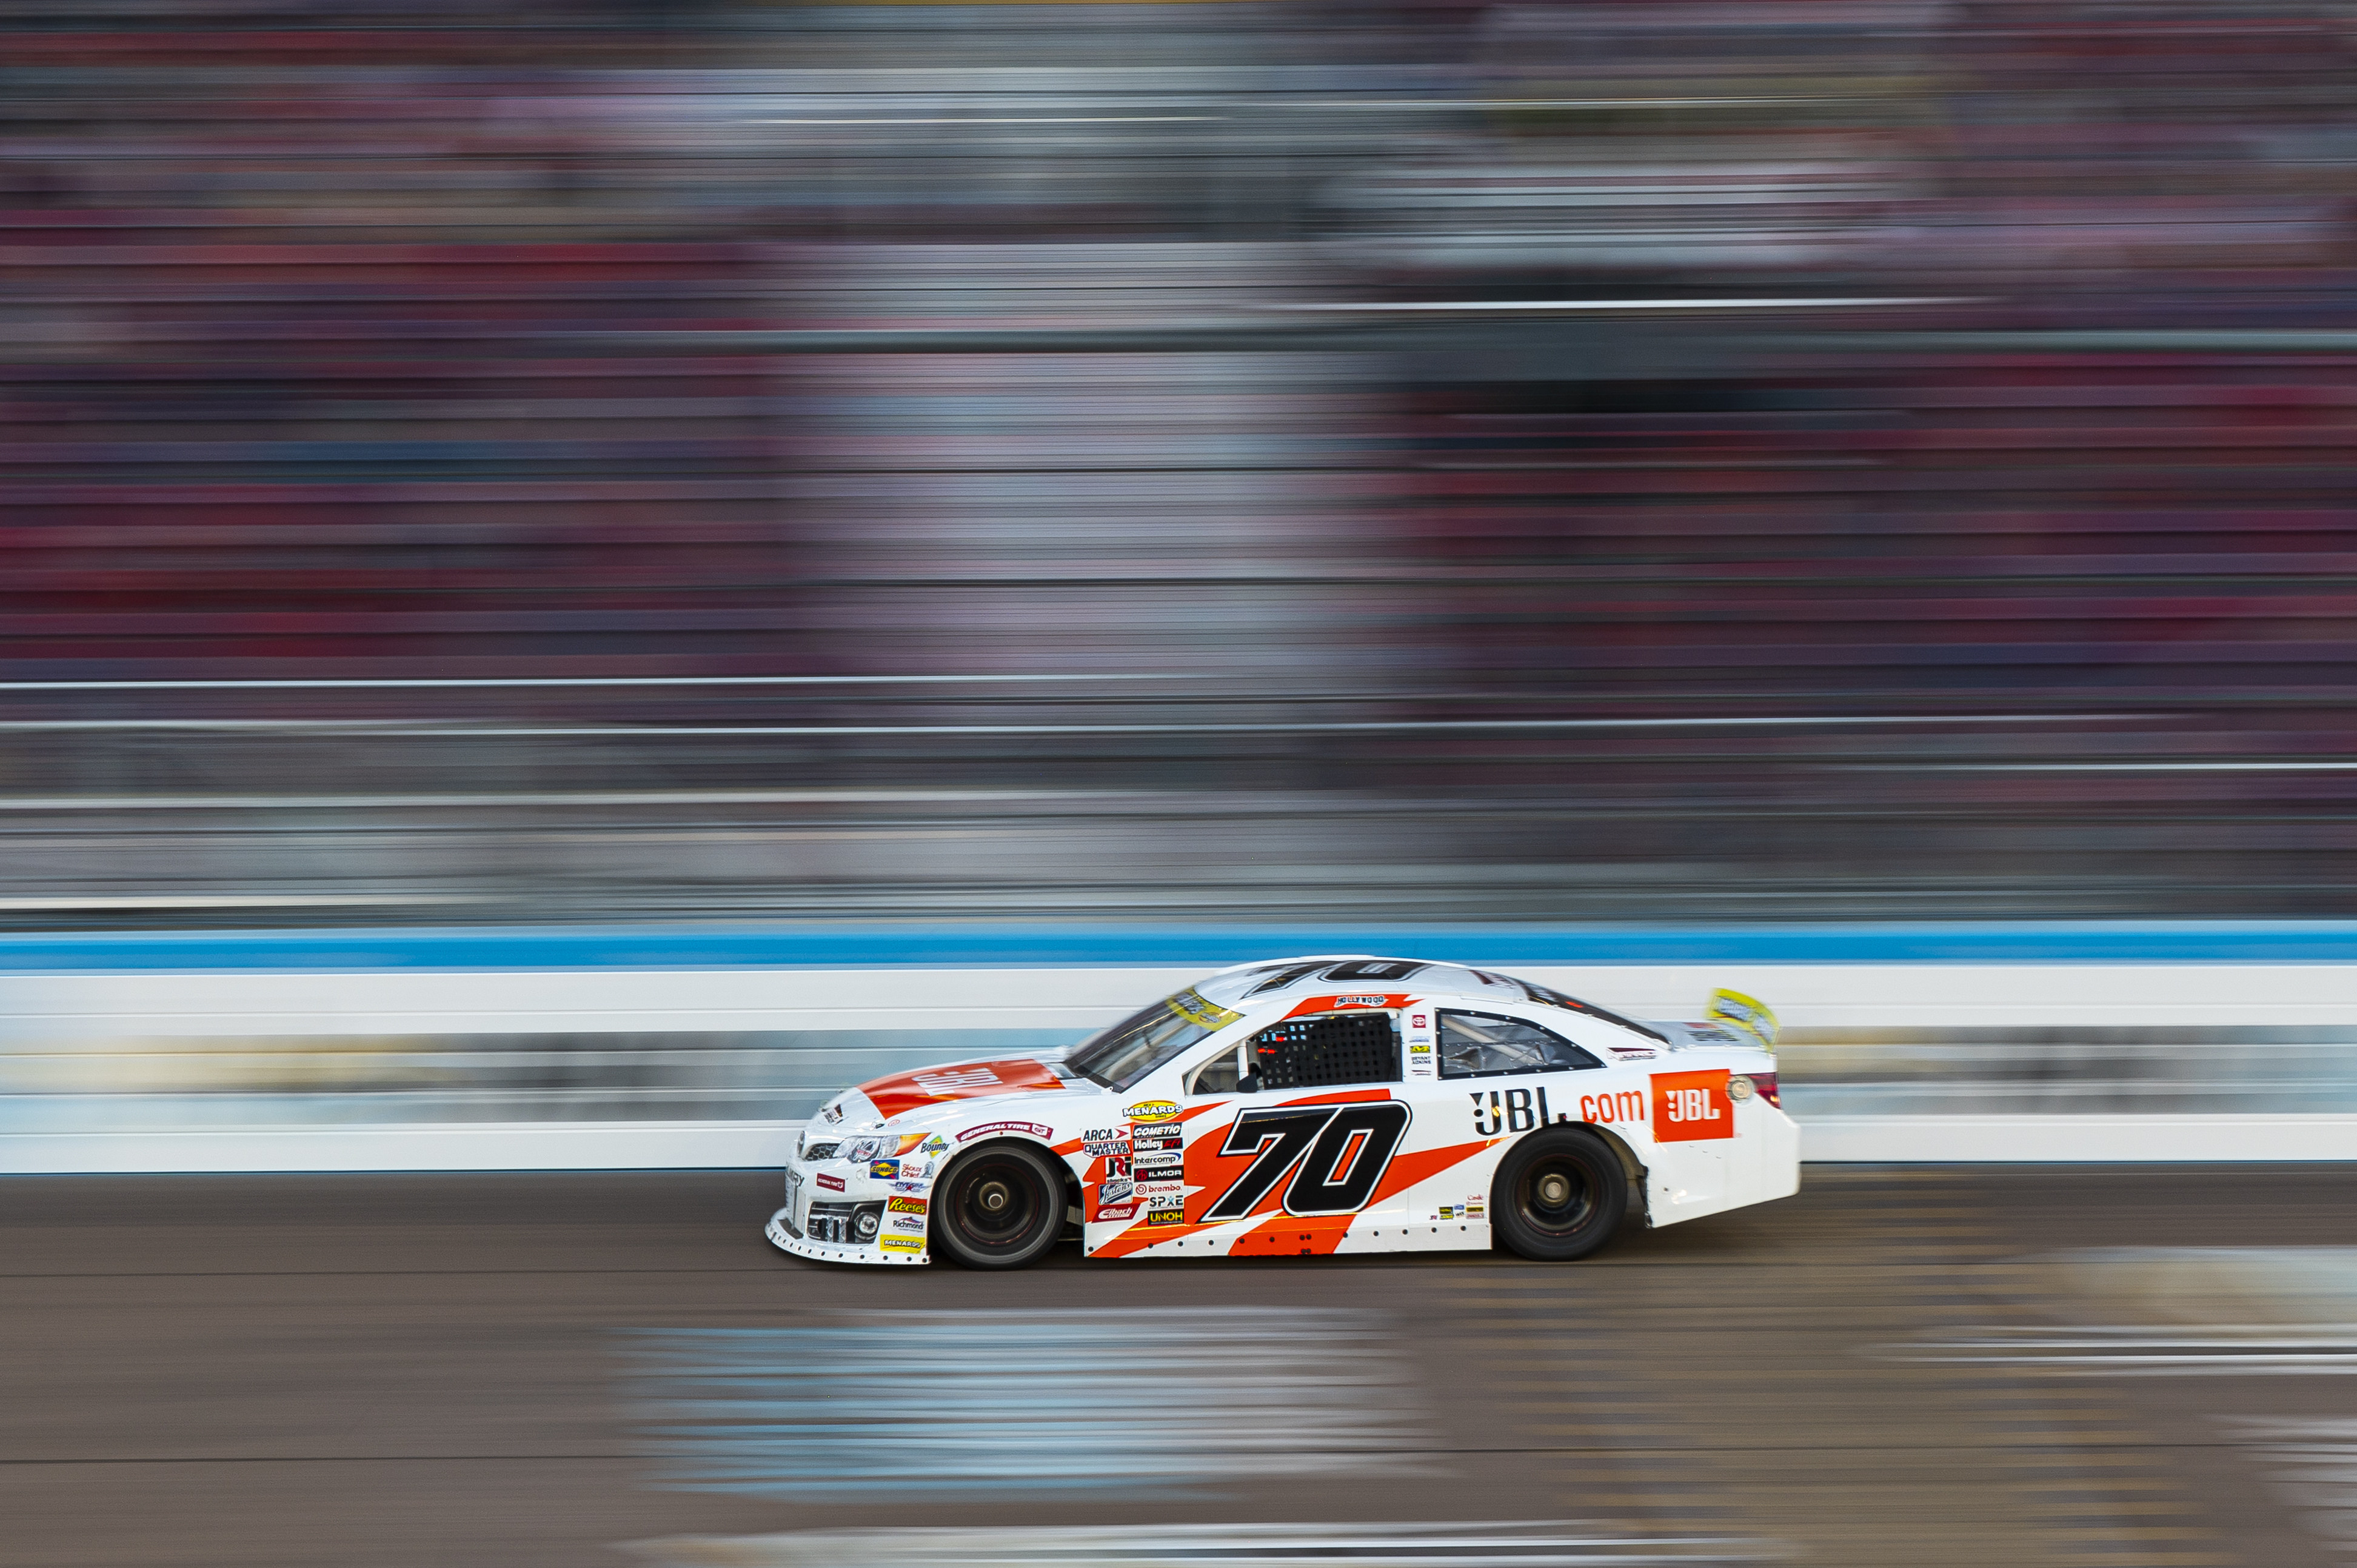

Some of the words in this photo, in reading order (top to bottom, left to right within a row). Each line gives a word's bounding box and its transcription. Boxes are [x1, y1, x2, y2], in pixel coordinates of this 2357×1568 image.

[1123, 1104, 1183, 1117] MENARDS
[1665, 1089, 1720, 1122] JBL
[960, 1124, 1007, 1141] GENERAL
[1083, 1129, 1113, 1141] ARCA
[920, 1143, 950, 1153] Bounty
[1085, 1143, 1126, 1153] QUARTER
[1134, 1139, 1163, 1150] Holley
[1092, 1148, 1129, 1157] MASTER
[1195, 1099, 1413, 1223] 70
[1150, 1212, 1183, 1222] UNOH
[893, 1219, 924, 1230] Richmond
[884, 1239, 921, 1249] MENARDS
